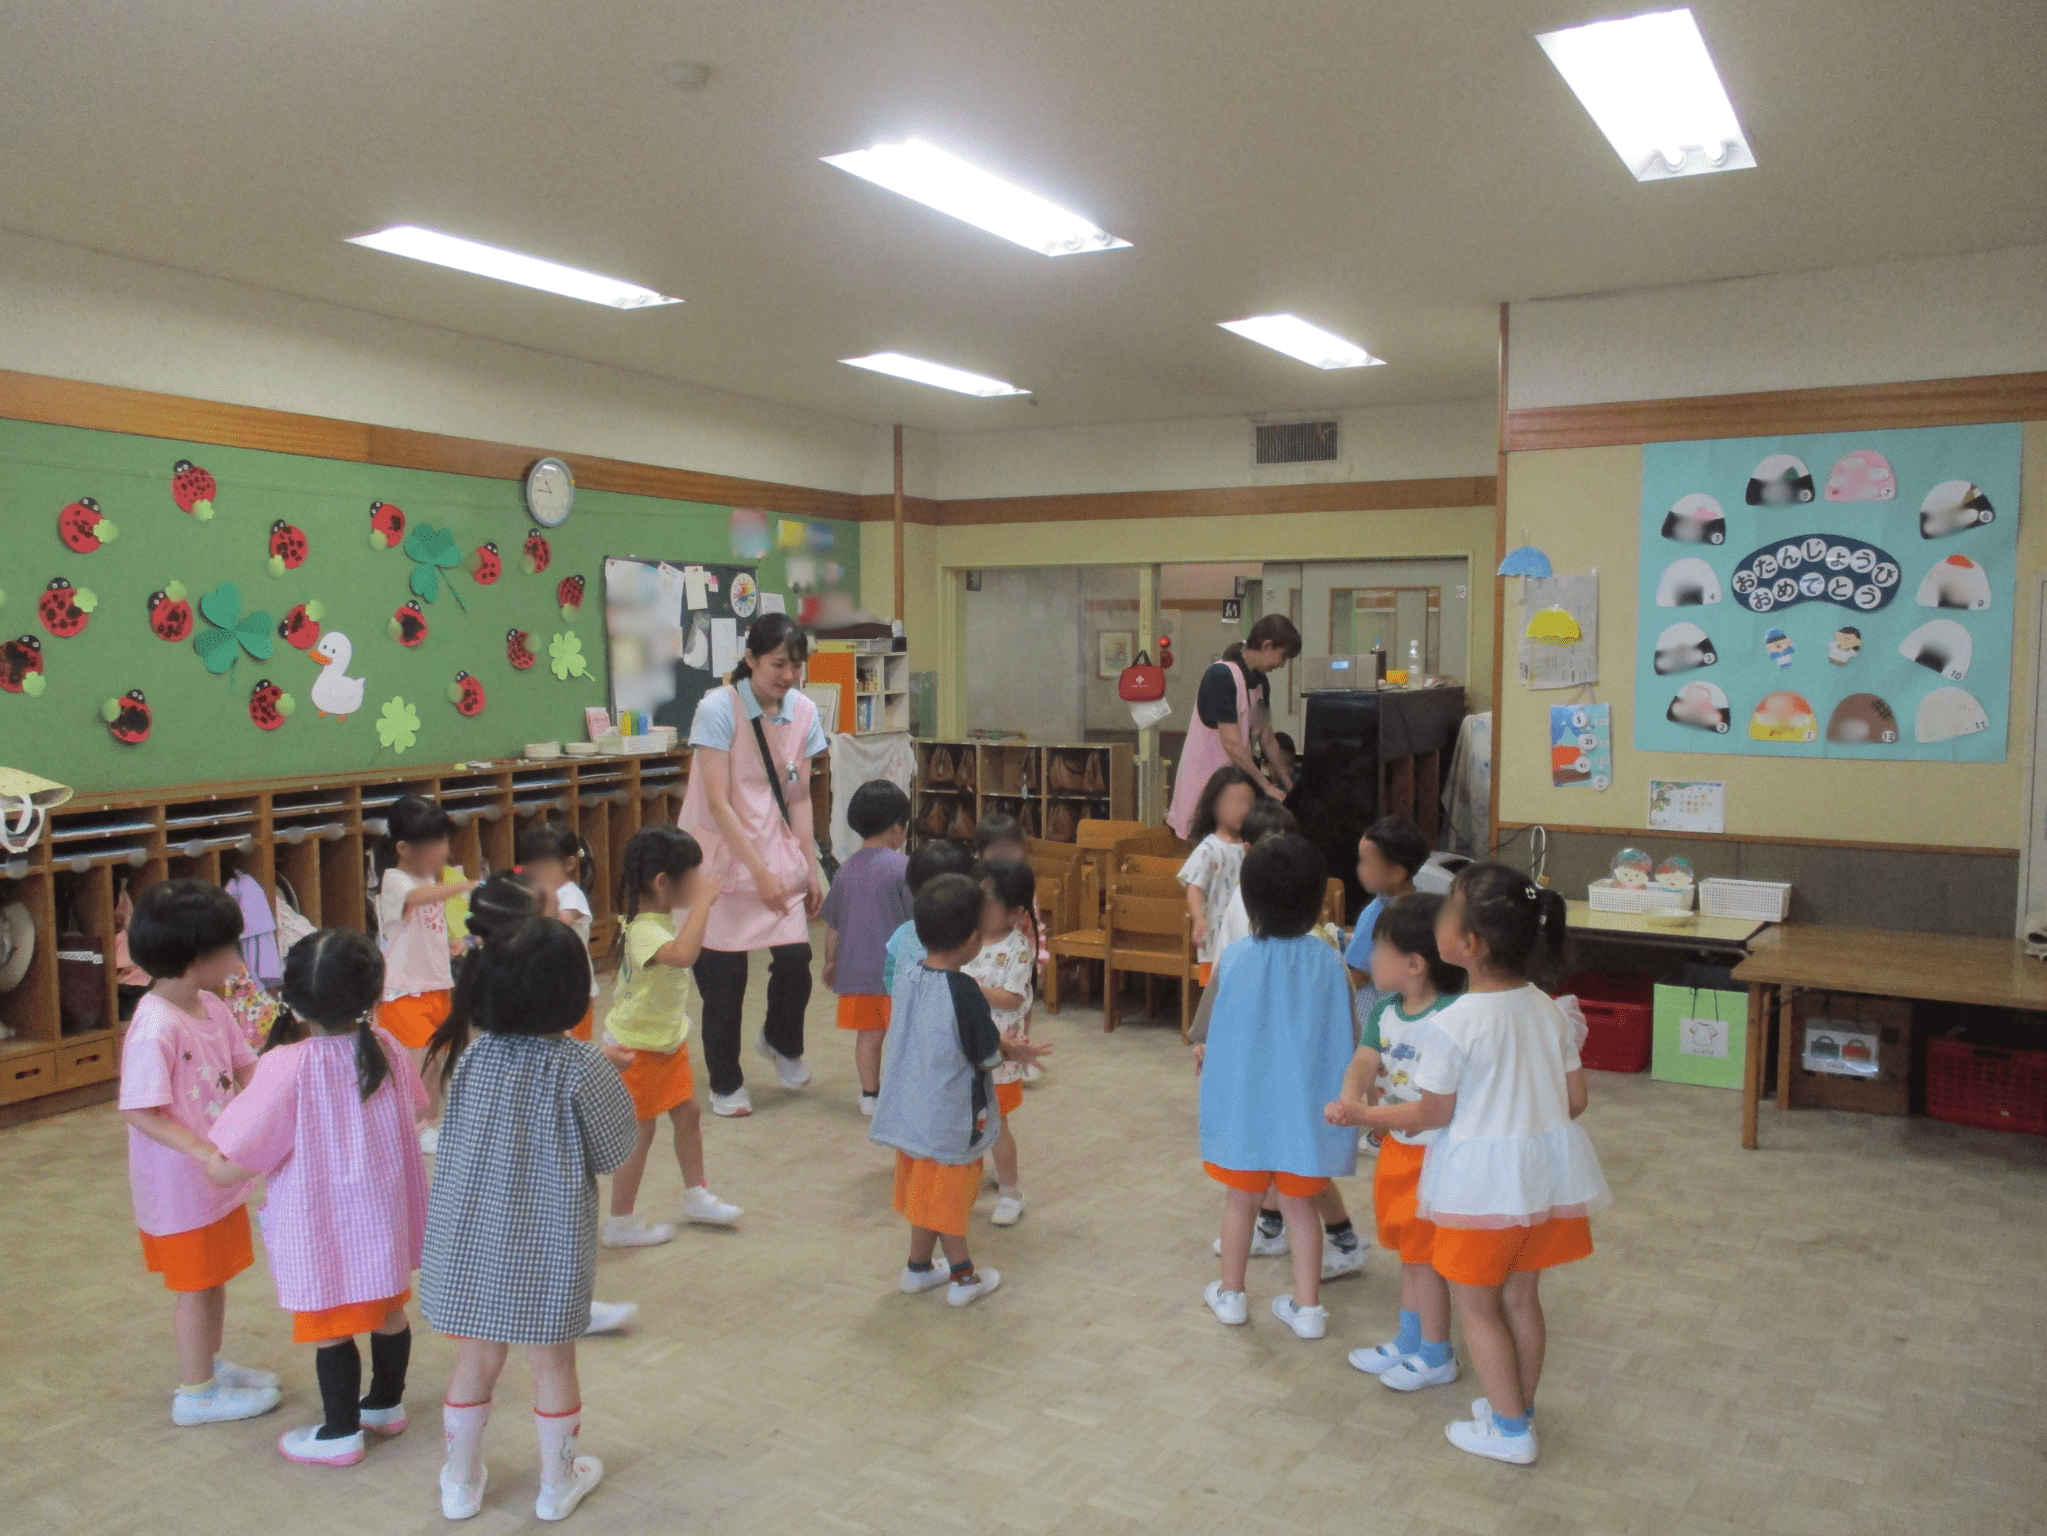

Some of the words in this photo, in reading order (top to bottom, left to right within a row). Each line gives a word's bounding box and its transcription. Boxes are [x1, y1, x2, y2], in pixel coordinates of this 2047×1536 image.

[1885, 488, 1891, 498] 7
[1715, 533, 1721, 542] 5
[1736, 541, 1896, 592] おたんじょうび
[1709, 592, 1715, 601] 4
[1753, 576, 1876, 610] おめでとう
[1706, 654, 1712, 662] 3
[1951, 669, 1962, 680] 10
[1576, 716, 1582, 724] 5
[1974, 720, 1986, 729] 11
[1719, 723, 1726, 732] 2
[1883, 732, 1894, 741] 12
